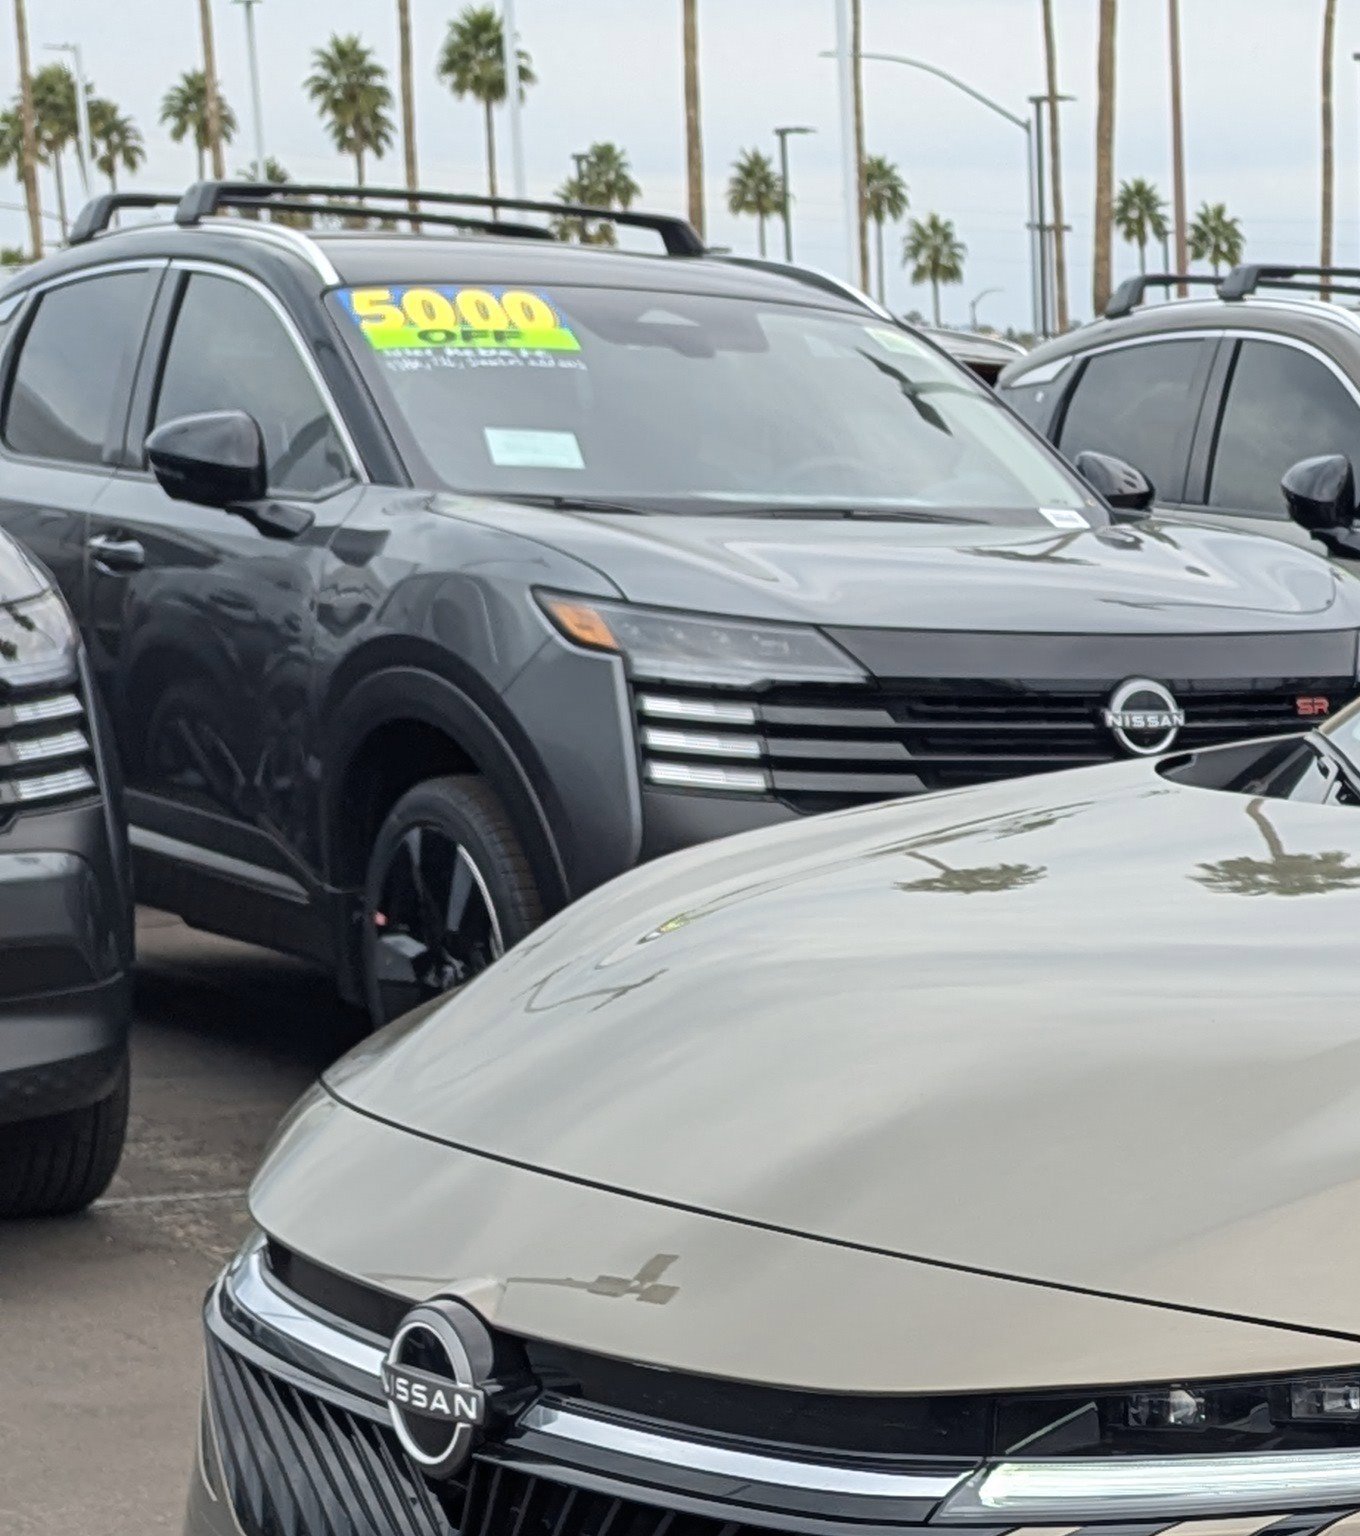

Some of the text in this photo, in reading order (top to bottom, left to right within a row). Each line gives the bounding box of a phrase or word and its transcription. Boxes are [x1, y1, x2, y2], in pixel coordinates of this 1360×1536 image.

[352, 288, 557, 330] 5000
[417, 328, 524, 345] OFF
[1296, 696, 1330, 715] SR
[1105, 710, 1185, 729] NISSAN
